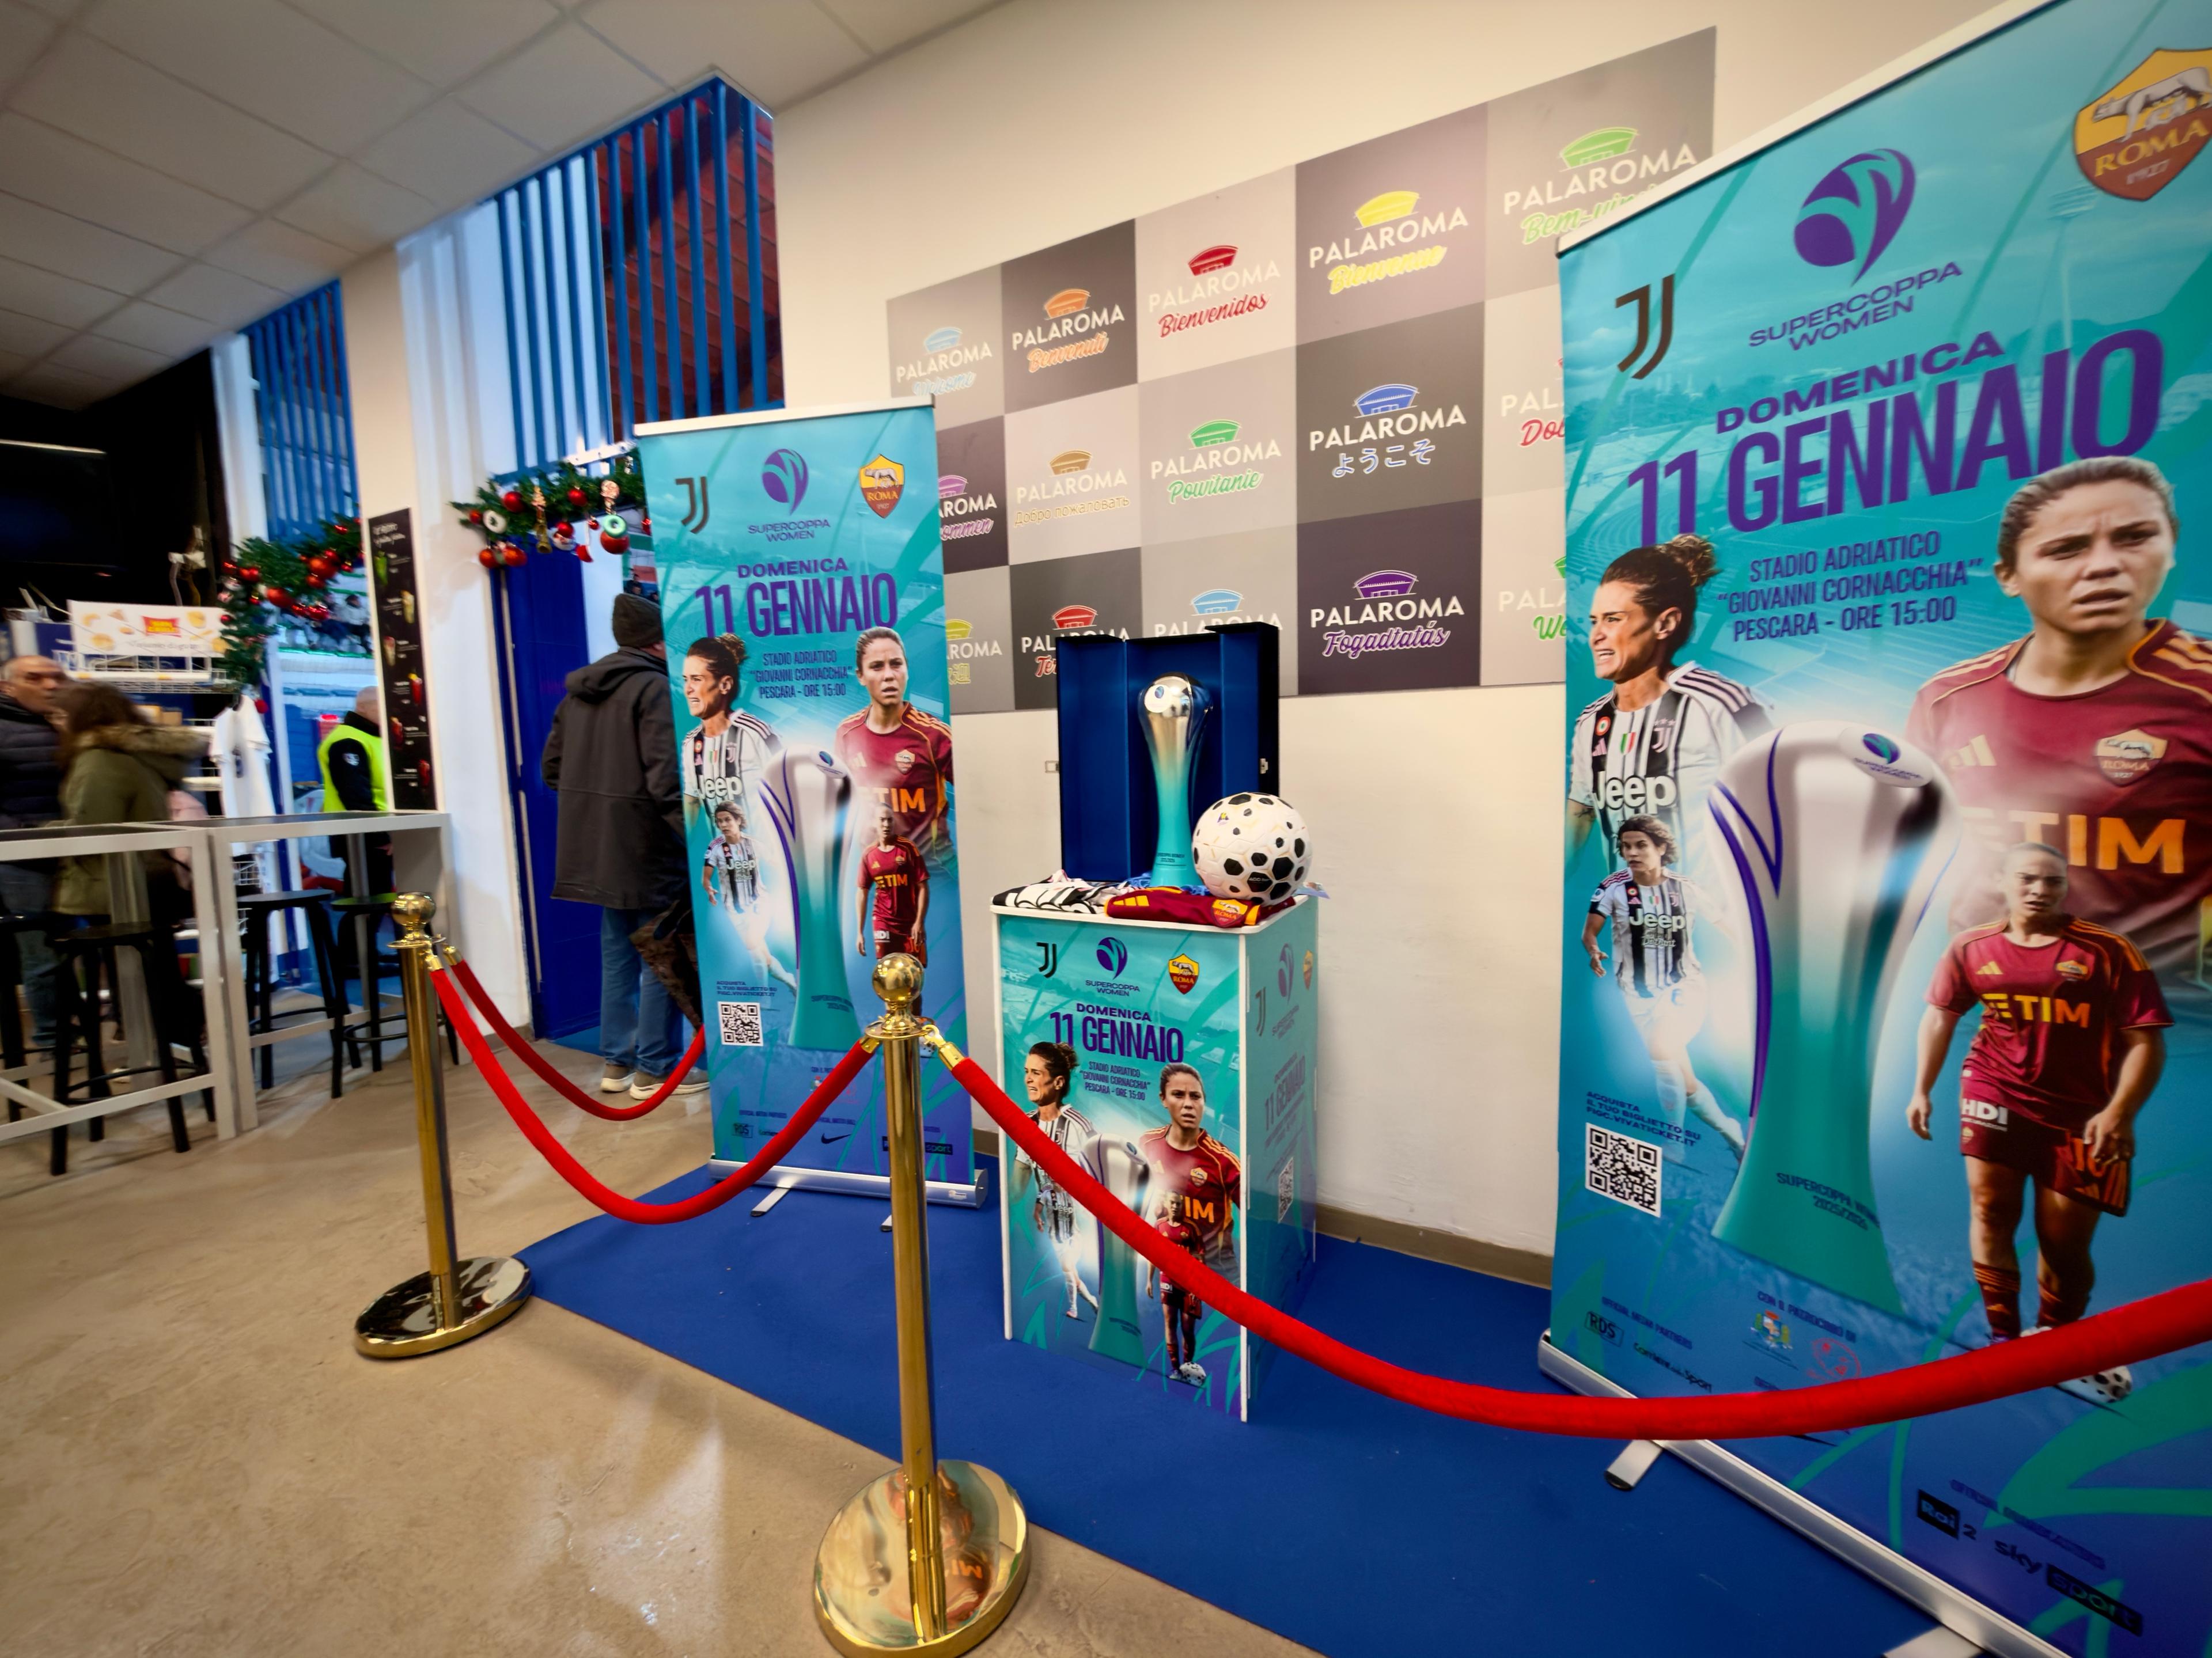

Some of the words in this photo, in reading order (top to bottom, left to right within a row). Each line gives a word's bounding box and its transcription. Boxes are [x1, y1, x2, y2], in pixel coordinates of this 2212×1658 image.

[2094, 119, 2210, 177] ROMA
[1503, 142, 1697, 215] PALAROMA
[1309, 207, 1468, 268] PALAROMA
[1148, 260, 1281, 313] PALAROMA
[1327, 245, 1447, 295] Bienvenue
[1158, 291, 1271, 338] Bienvenidos
[1749, 261, 1963, 348] SUPERCOPPA
[1012, 304, 1125, 351] PALAROMA
[1789, 295, 1915, 352] WOMEN
[896, 342, 993, 382] PALAROMA
[1028, 331, 1109, 373] Benvenuti
[1716, 331, 2005, 434] DOMENICA
[1310, 405, 1467, 451] PALAROMA
[1628, 449, 1698, 548] 11
[1727, 329, 2165, 534] GENNAIO
[1152, 439, 1282, 480] PALAROMA
[1332, 438, 1435, 479] ようこそ
[867, 490, 899, 502] ROMA
[1016, 468, 1127, 504] PALAROMA
[1167, 468, 1264, 504] Powitanie
[1054, 495, 1131, 518] пожаловать
[747, 519, 831, 534] SUPERCOPPA
[765, 530, 815, 542] WOMEN
[737, 557, 849, 579] DOMENICA
[1749, 549, 1817, 583] STADIO
[1824, 530, 1941, 572] ADRIATICO
[695, 584, 736, 639] 11
[747, 572, 899, 638] GENNAIO
[1310, 595, 1465, 628] PALAROMA
[1733, 610, 1820, 642] PESCARA
[1841, 602, 1883, 632] ORE
[1891, 595, 1957, 626] 15:00
[1323, 620, 1450, 659] Fogadtatás
[763, 651, 792, 666] STADIO
[794, 650, 837, 665] ADRIATICO
[759, 684, 796, 699] PESCARA
[804, 684, 821, 697] ORE
[822, 683, 846, 697] 15:00
[699, 775, 743, 801] Jeep
[1593, 771, 1677, 814] Jeep
[727, 858, 756, 871] Jeep
[1629, 908, 1687, 932] Jeep
[1085, 980, 1140, 992] SUPERCOPPA
[1097, 988, 1130, 997] WOMEN
[1172, 975, 1195, 984] ROMA
[1076, 1003, 1152, 1022] DOMENICA
[1050, 1012, 1074, 1048] 11
[1082, 1016, 1184, 1064] GENNAIO
[1089, 1061, 1109, 1073] STADIO
[1110, 1064, 1140, 1077] ADRIATICO
[1085, 1082, 1110, 1095] PESCARA
[1116, 1088, 1127, 1099] ORE
[1587, 1091, 1641, 1113] ACQUISTA
[1597, 1102, 1620, 1115] TUO
[1622, 1110, 1683, 1134] BIGLIETTO
[1588, 1311, 1617, 1340] RDS
[1994, 1539, 2043, 1574] sky
